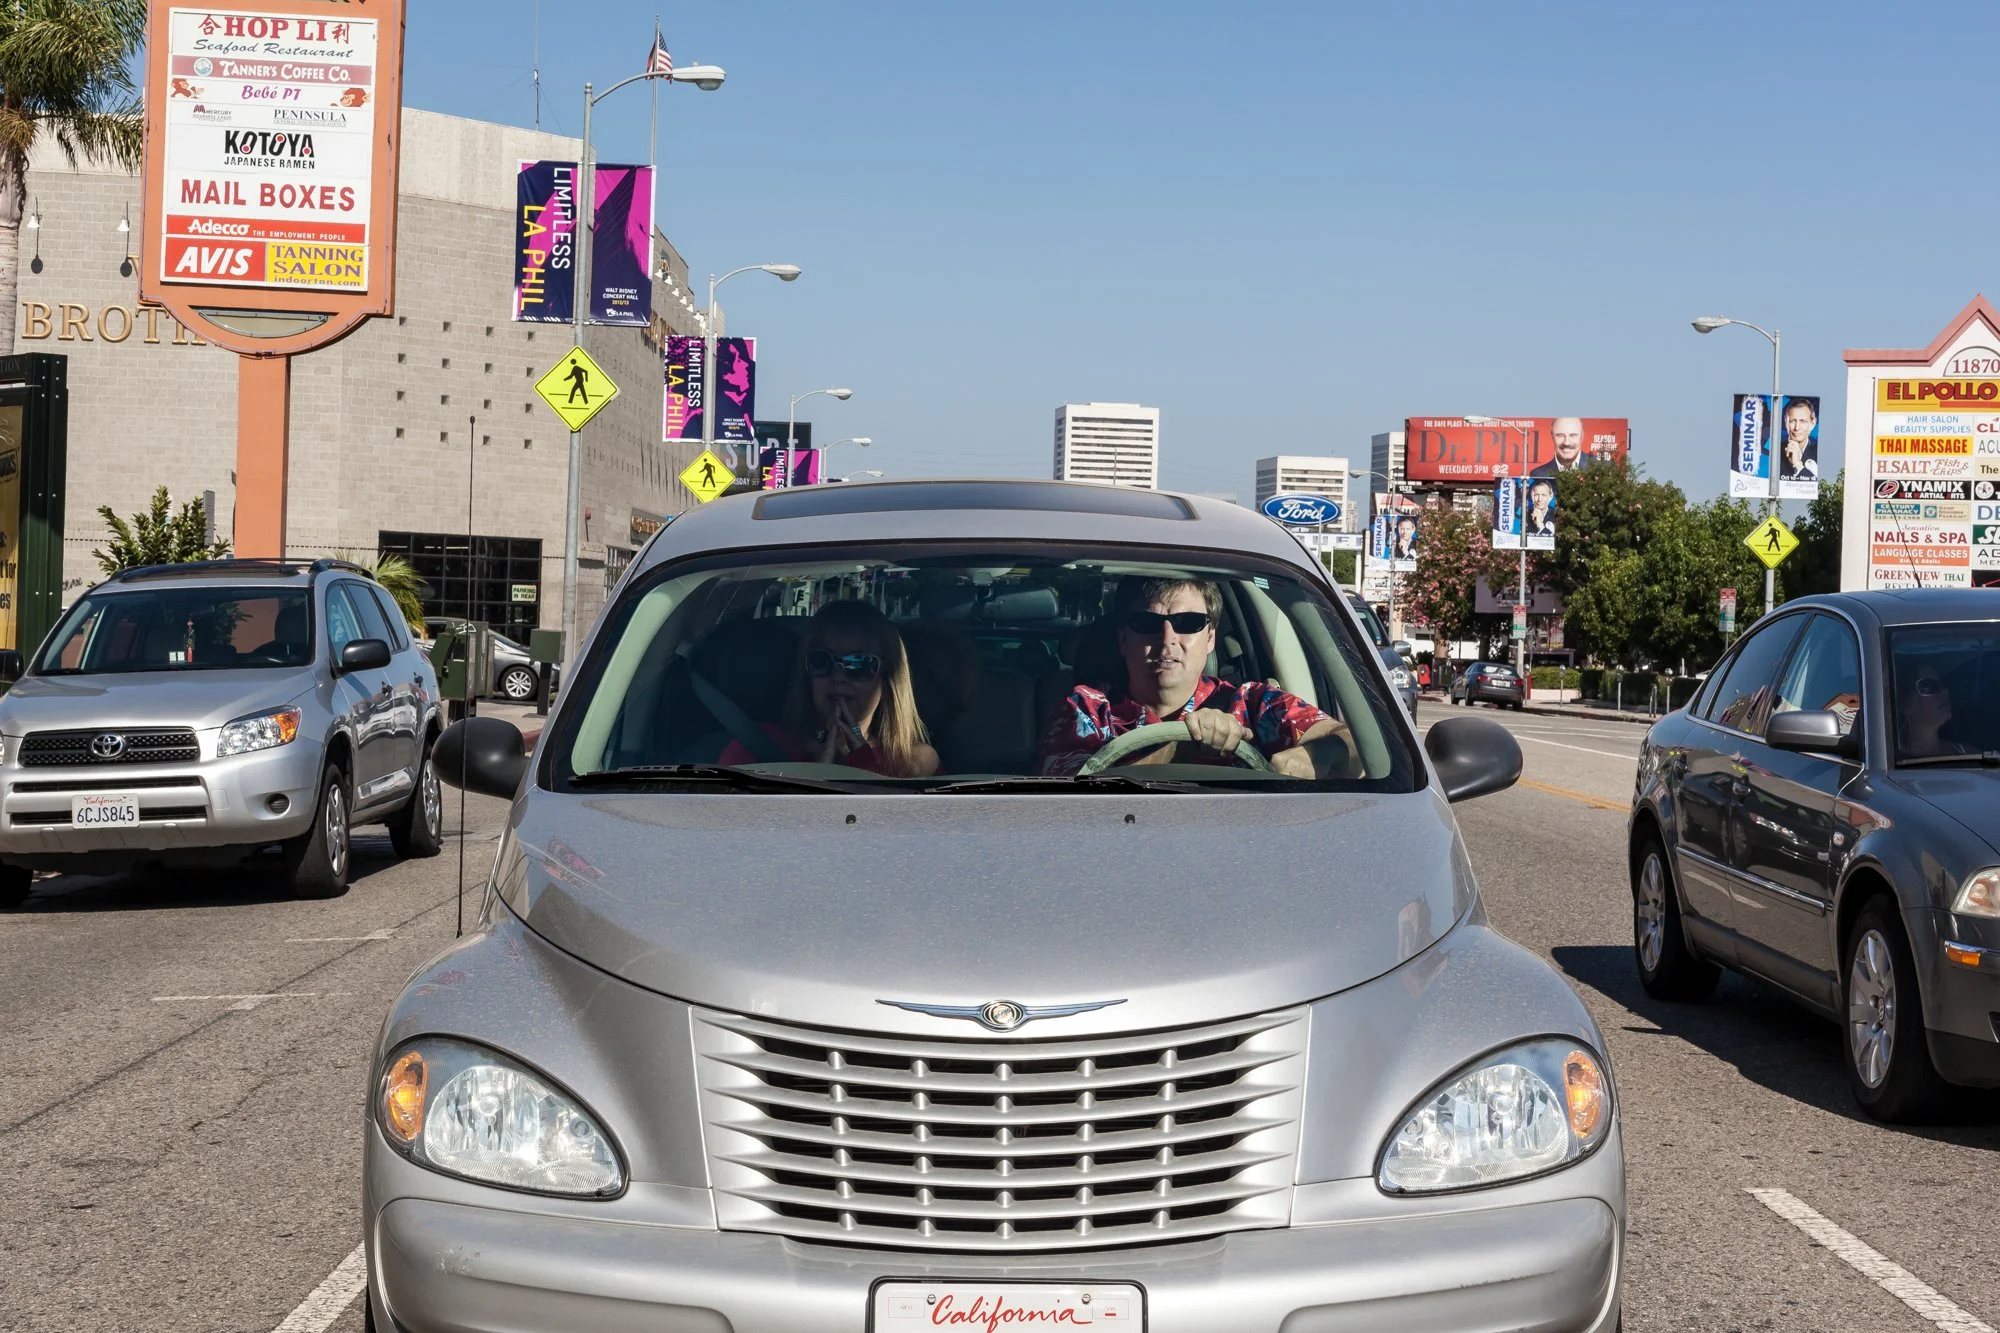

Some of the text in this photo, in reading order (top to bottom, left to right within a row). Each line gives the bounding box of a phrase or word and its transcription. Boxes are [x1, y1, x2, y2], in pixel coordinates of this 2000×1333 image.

[199, 14, 221, 36] 合
[224, 17, 327, 42] HOP LI
[332, 22, 350, 44] 利
[194, 40, 353, 57] Seafood Restaurant
[281, 64, 324, 80] COFFEE
[242, 85, 301, 100] Bebé PT
[274, 109, 346, 121] PENINSULA
[225, 130, 314, 158] KOTOYA
[224, 157, 315, 169] JAPANESE RAMEN
[181, 179, 354, 211] MAIL BOXES
[552, 168, 572, 269] LIMITLESS
[188, 219, 250, 235] Adecco
[270, 231, 316, 239] EMPLOYMENT
[175, 246, 253, 276] AVIS
[272, 245, 363, 262] TANNING
[520, 205, 547, 310] LA PHIL
[274, 261, 361, 277] SALON
[274, 277, 361, 286] indoortan.com
[688, 340, 701, 407] LIMITLESS
[667, 365, 684, 435] LA PHIL
[1887, 382, 1998, 400] EL POLLO
[1743, 400, 1756, 472] SEMINAR
[1419, 430, 1540, 463] Dr. Phil
[1880, 439, 1967, 453] THAI MASSAGE
[762, 466, 773, 481] LA
[1439, 465, 1488, 474] WEEKDAYS 3PM
[1980, 465, 1999, 474] The
[1278, 499, 1325, 520] Ford
[1502, 481, 1510, 530] SEMINAR
[1875, 531, 1967, 543] NAILS & SPA
[1874, 548, 1968, 558] LANGUAGE CLASSES
[1875, 569, 1940, 580] GREENVIEW
[77, 805, 134, 823] 6CJS845
[932, 1294, 1093, 1333] California
